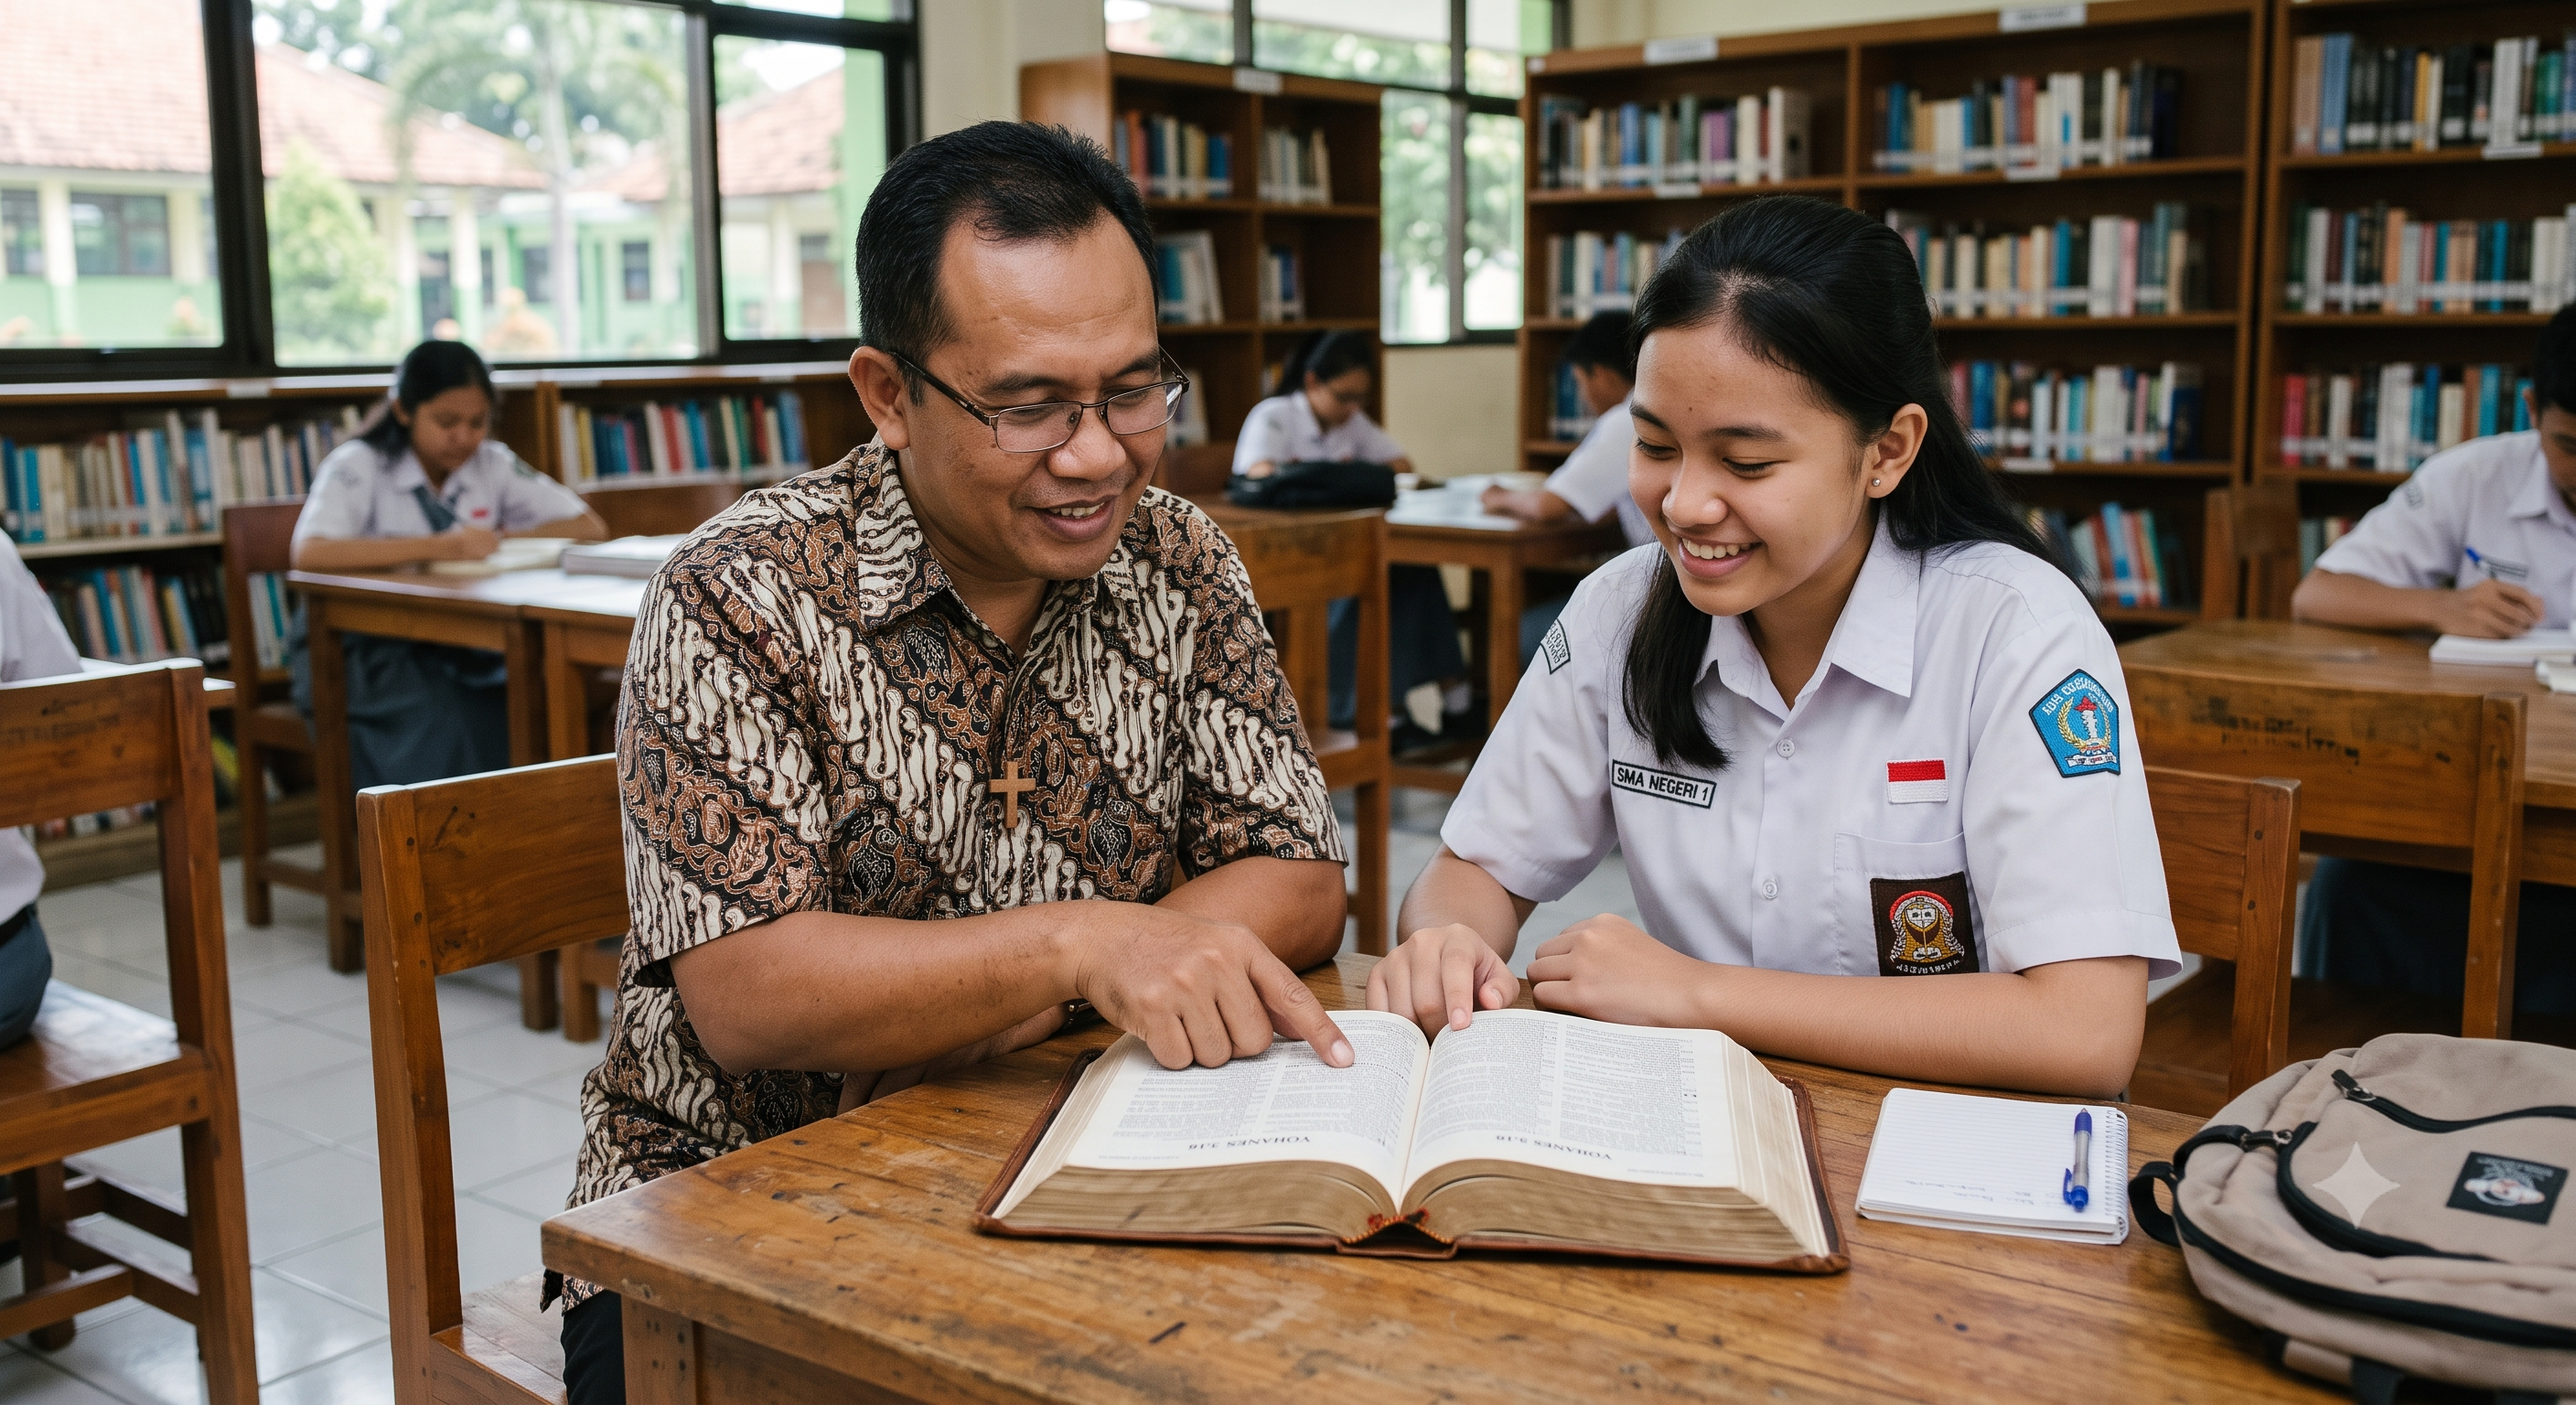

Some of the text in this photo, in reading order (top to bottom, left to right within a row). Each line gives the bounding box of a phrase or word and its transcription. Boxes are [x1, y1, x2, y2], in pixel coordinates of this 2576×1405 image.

[1617, 767, 1709, 801] SMA NEGERI 1
[1227, 1136, 1310, 1148] YOHANES
[1534, 1140, 1612, 1159] YOHANES
